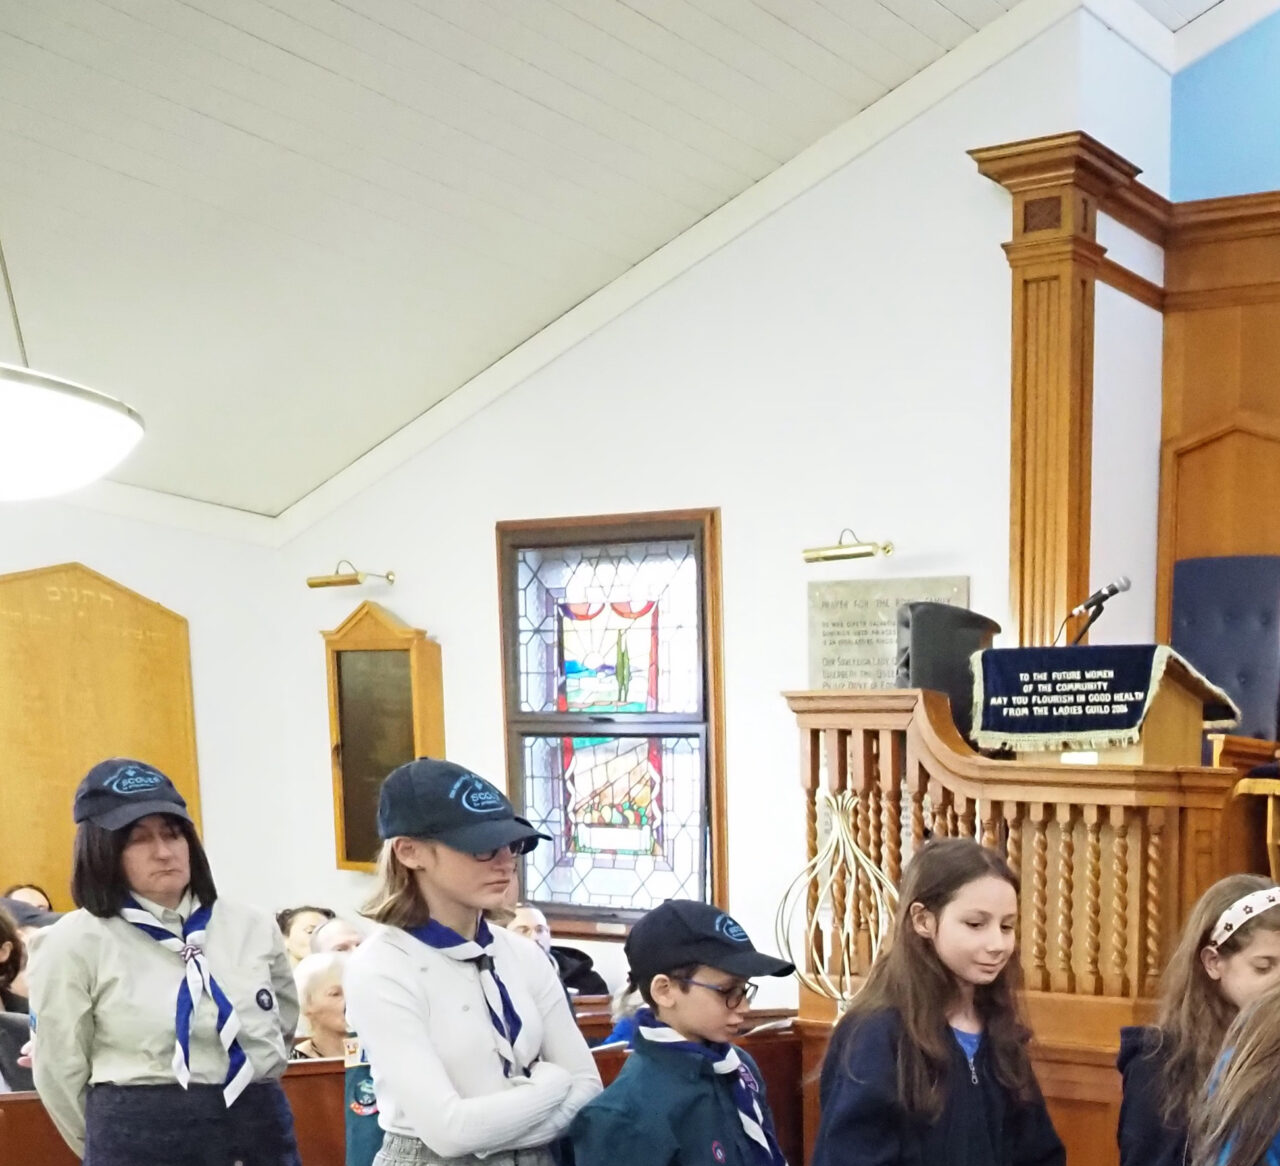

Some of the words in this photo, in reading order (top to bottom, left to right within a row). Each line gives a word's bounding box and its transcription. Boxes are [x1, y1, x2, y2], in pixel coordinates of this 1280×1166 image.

[1019, 672, 1030, 682] TO
[1032, 671, 1048, 681] THE
[1051, 670, 1082, 681] FUTURE
[1084, 669, 1115, 680] WOMEN
[1022, 683, 1034, 694] OF
[1037, 683, 1053, 693] THE
[1055, 680, 1109, 693] COMMUNITY
[989, 696, 1008, 706] MAY
[1011, 695, 1029, 706] YOU
[1031, 694, 1075, 705] FLOURISH
[1075, 693, 1086, 703] IN
[1087, 692, 1112, 703] GOOD
[1113, 691, 1145, 702] HEALTH
[1002, 706, 1030, 717] FROM
[1032, 705, 1049, 716] THE
[1052, 705, 1084, 716] LADIES
[1084, 704, 1111, 715] GUILD
